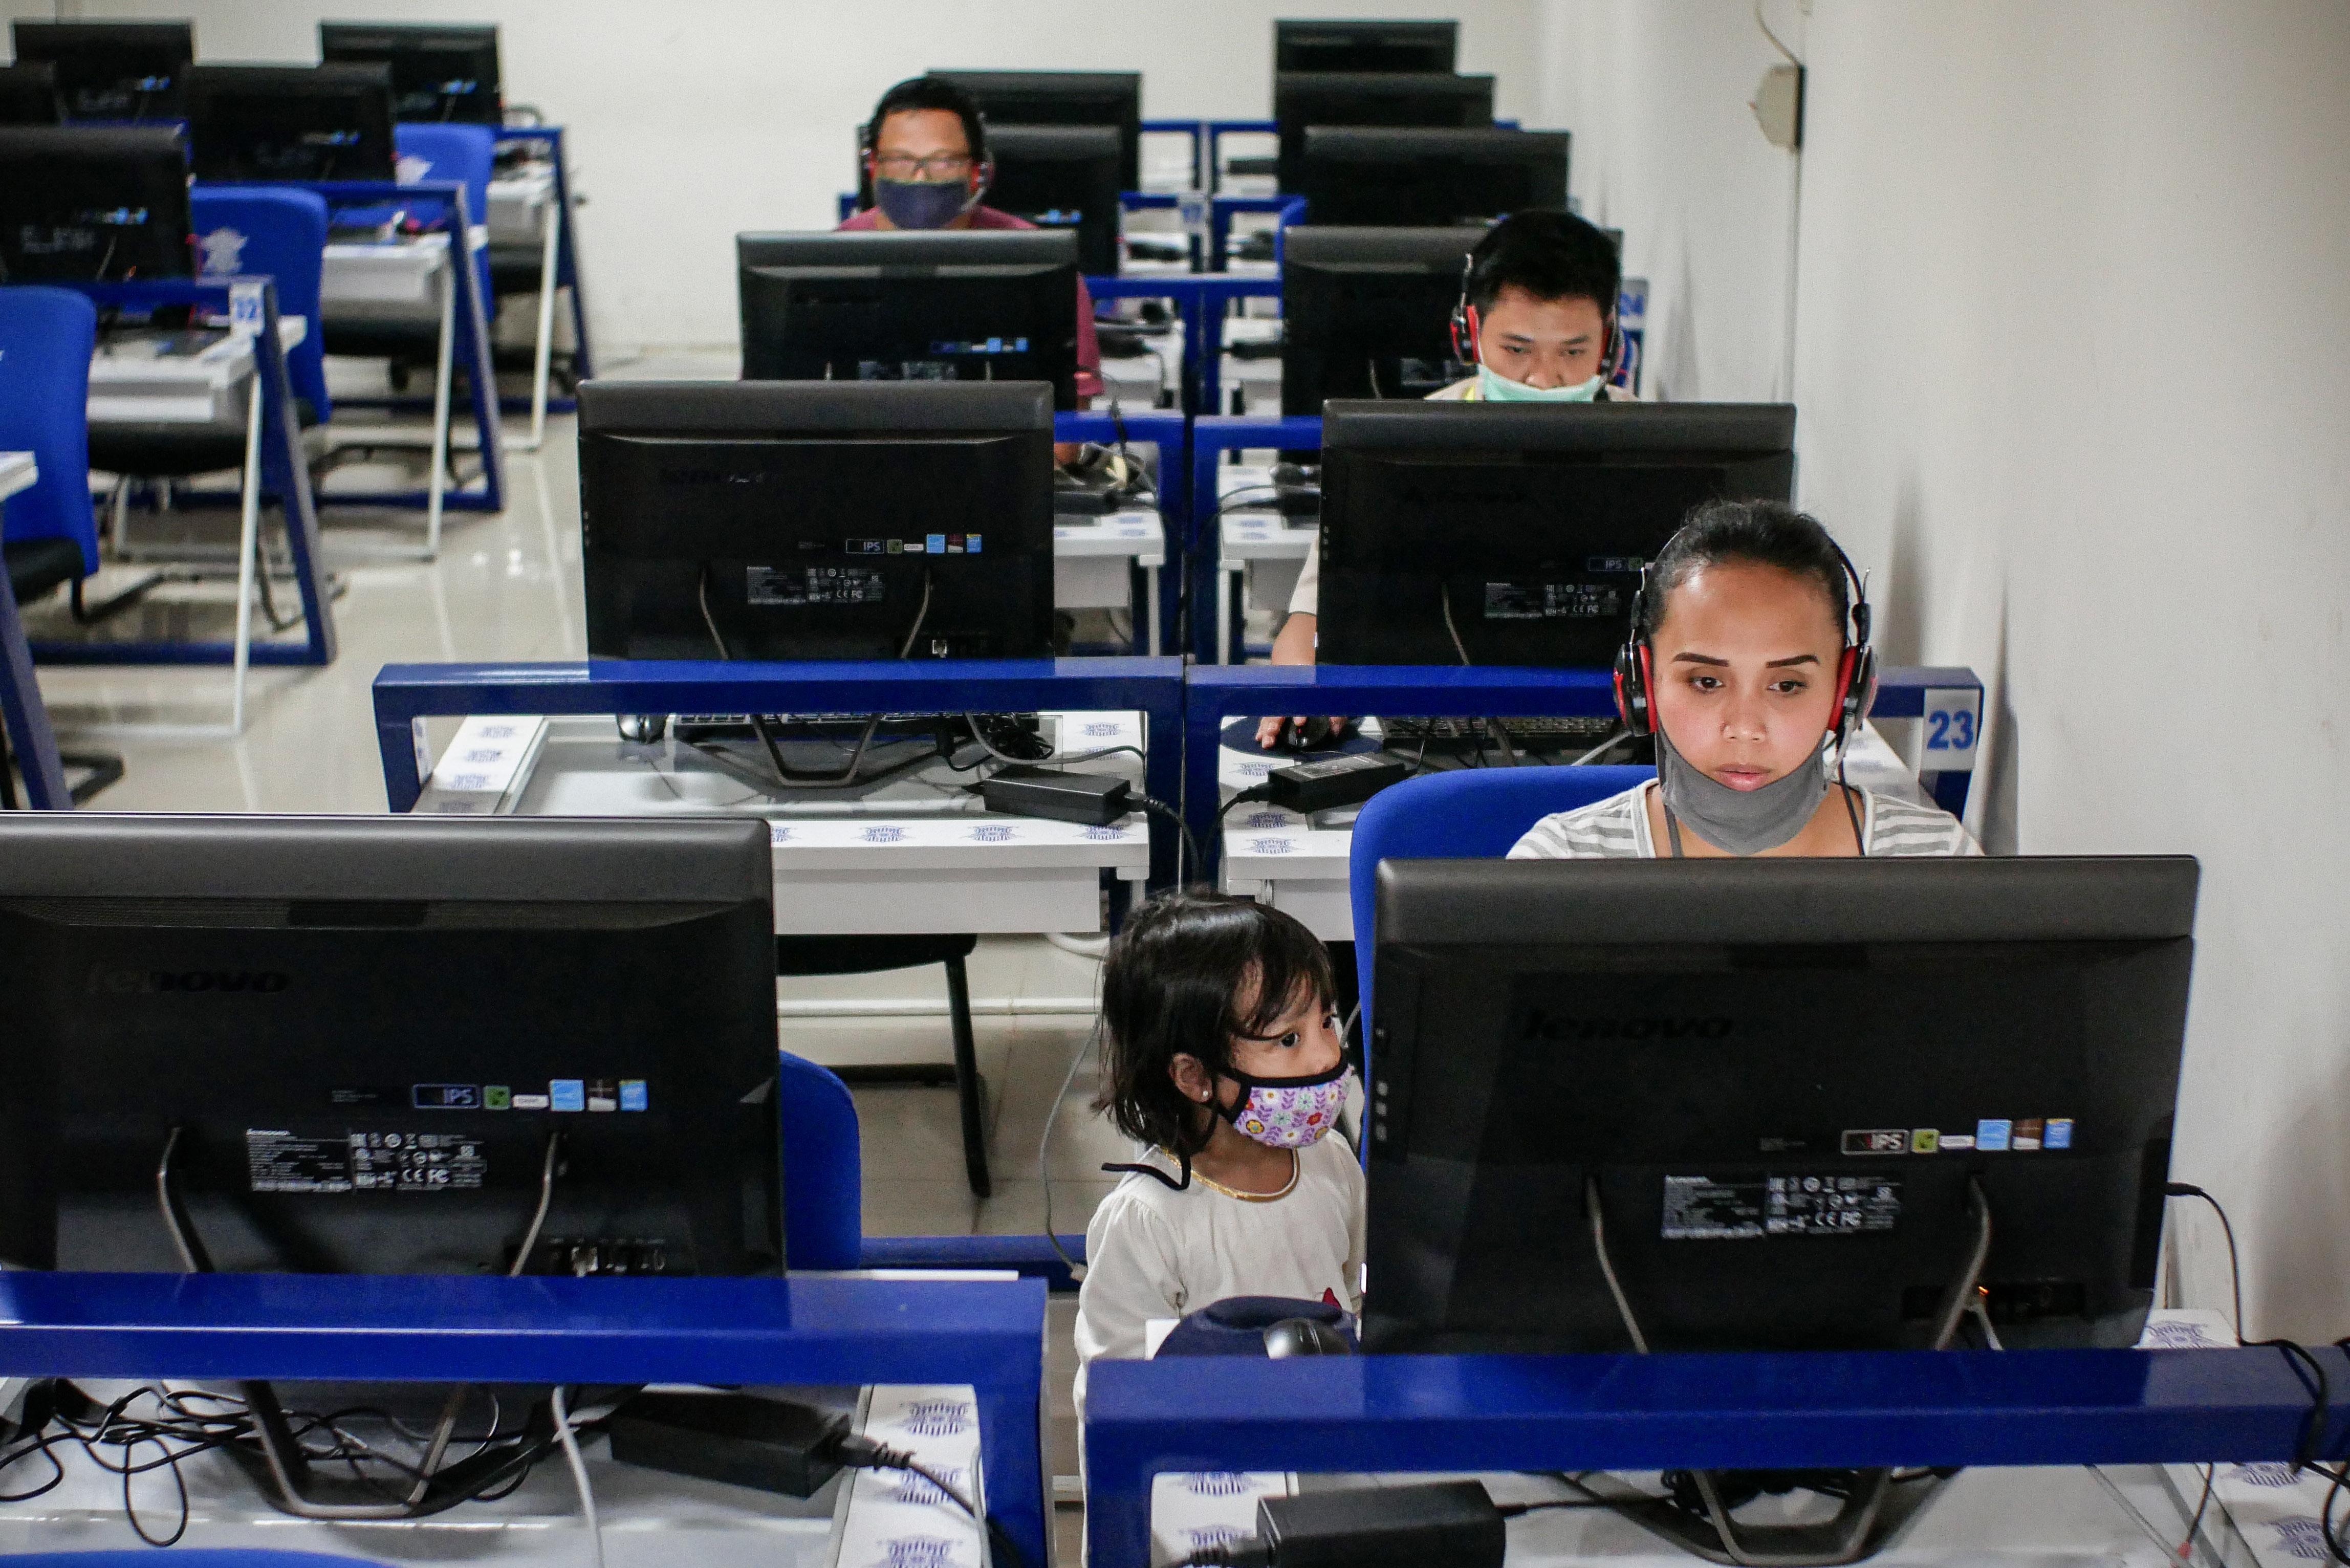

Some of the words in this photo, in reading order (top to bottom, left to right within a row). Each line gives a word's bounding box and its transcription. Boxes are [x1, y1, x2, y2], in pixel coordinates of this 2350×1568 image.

[1927, 710, 1973, 750] 23
[1522, 1006, 1734, 1040] lenovo
[444, 1087, 473, 1104] IPS
[1872, 1133, 1903, 1150] IPS
[402, 1167, 424, 1183] CE
